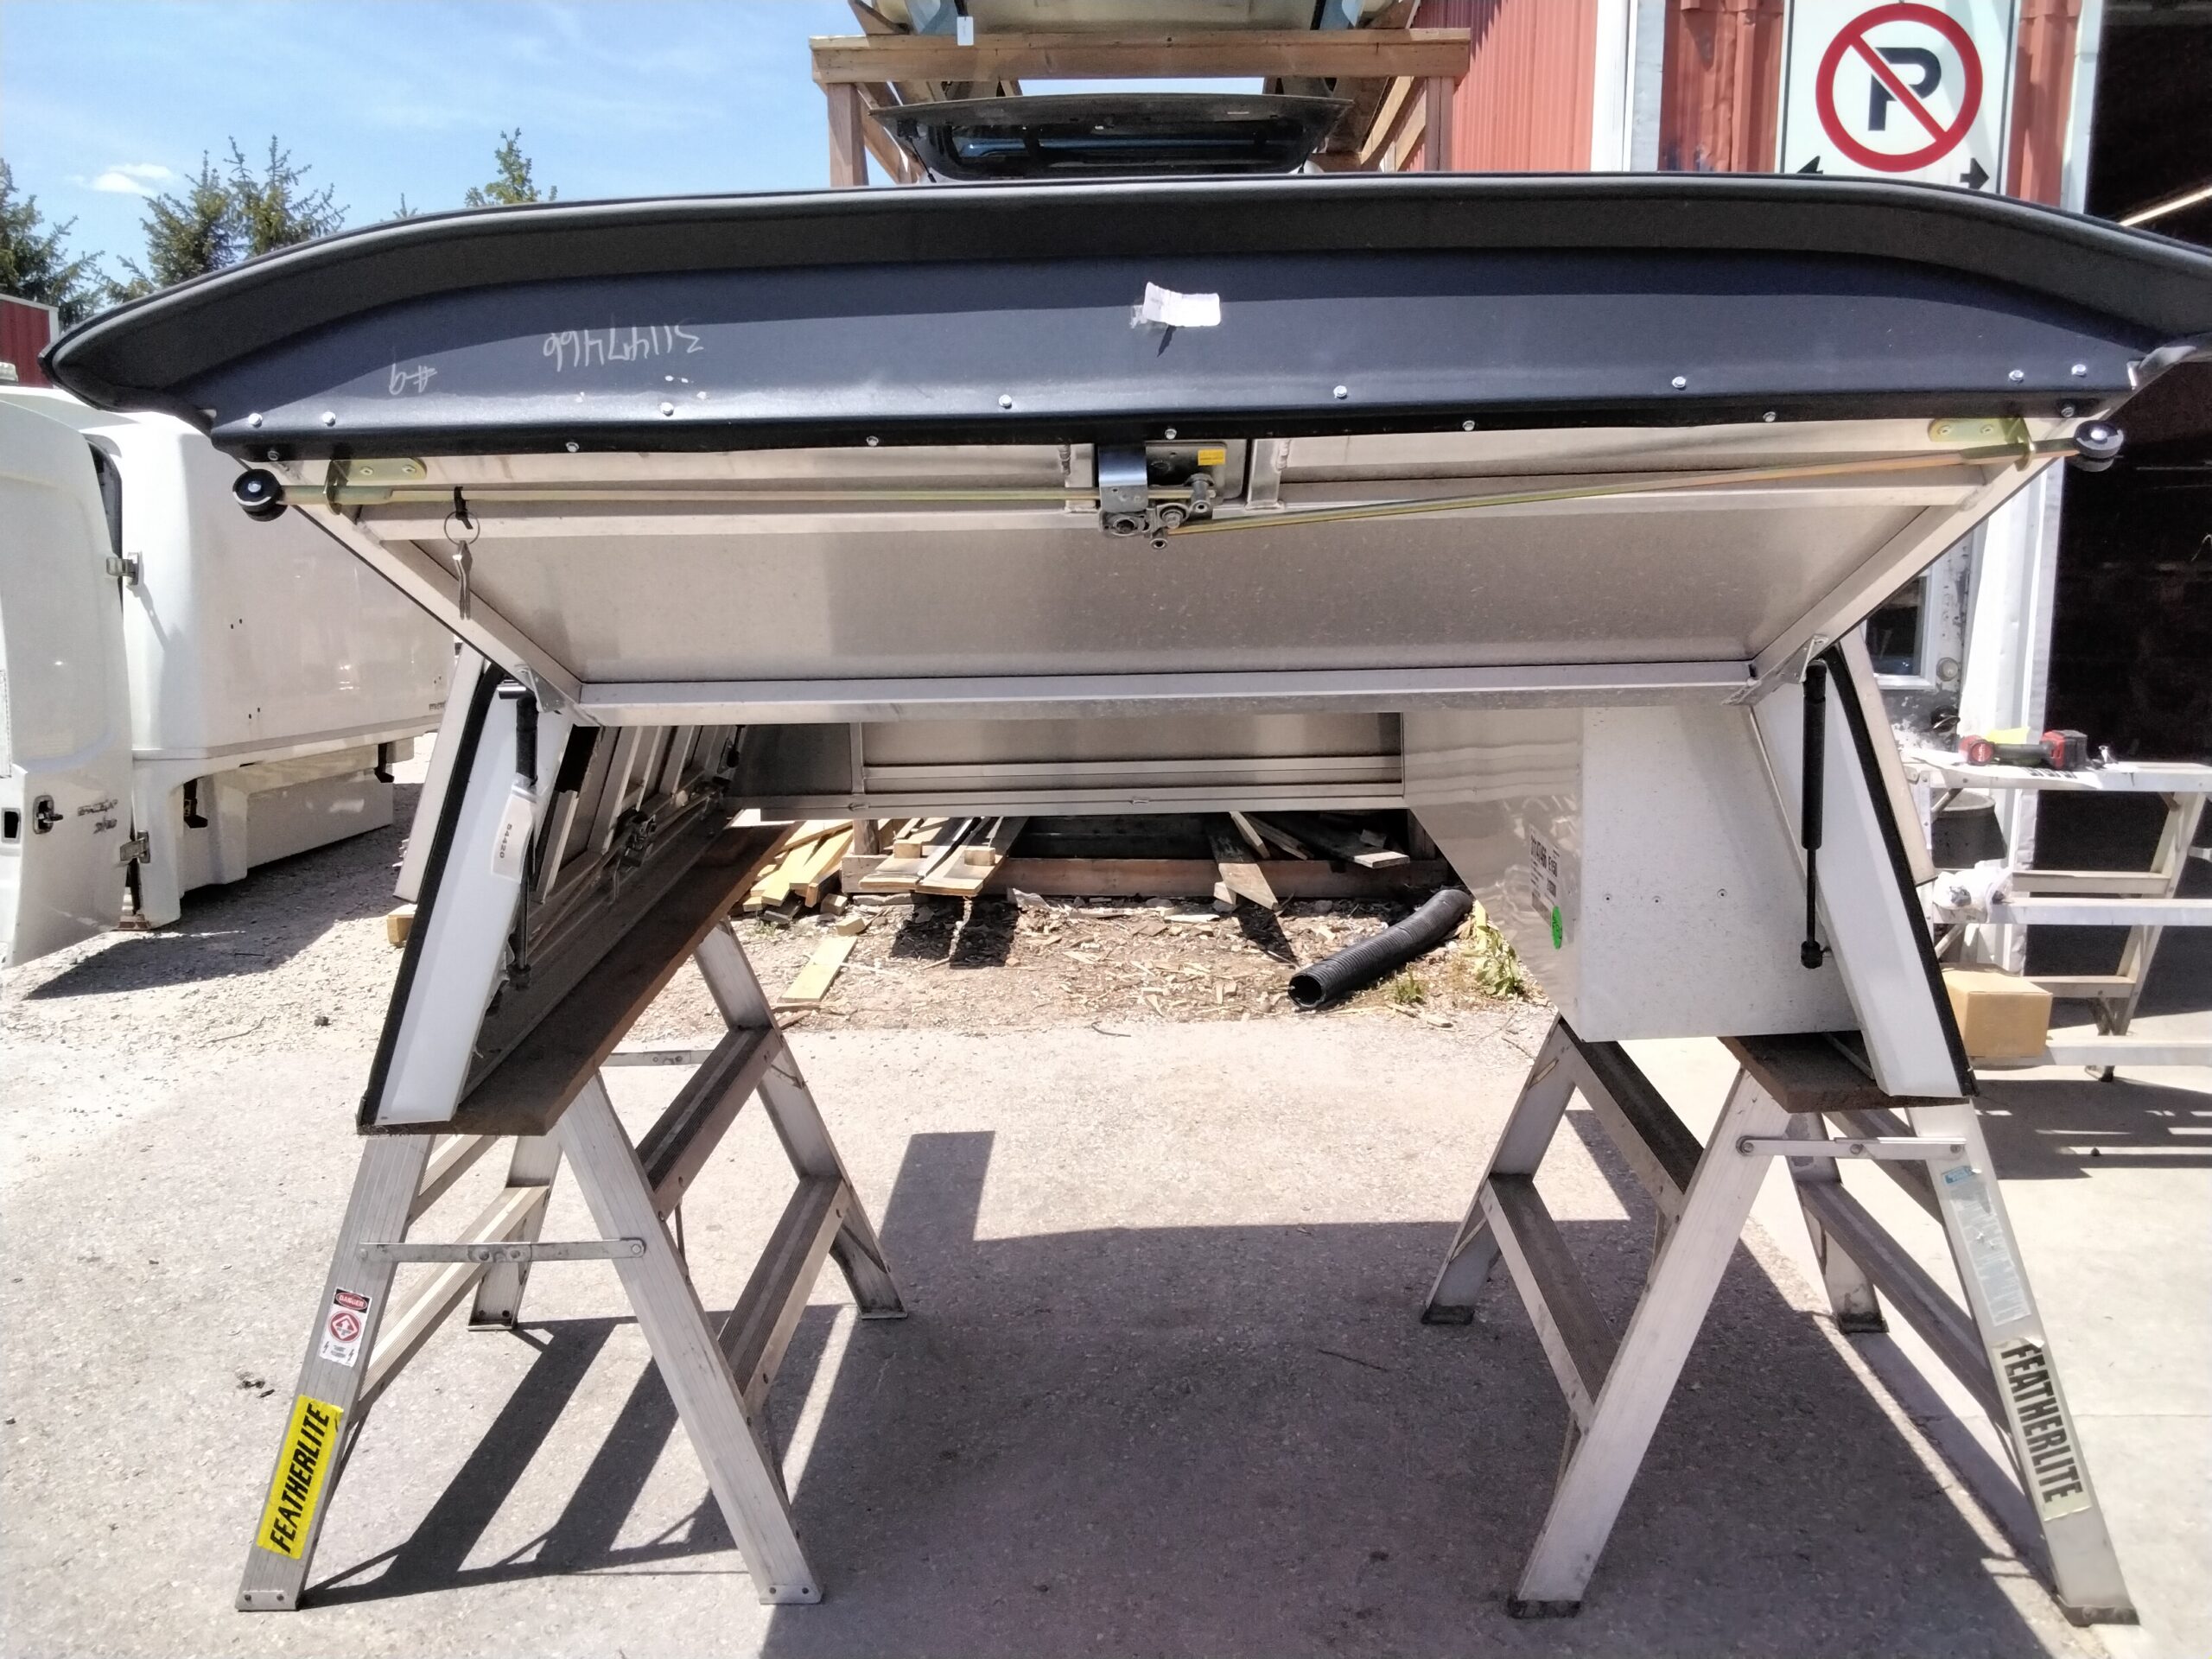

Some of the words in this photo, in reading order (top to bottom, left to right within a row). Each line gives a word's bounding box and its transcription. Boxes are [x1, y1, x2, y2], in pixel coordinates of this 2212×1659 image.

[1868, 47, 1942, 131] P
[270, 1402, 330, 1554] FEATHERLITE
[2001, 1344, 2083, 1503] FEATHERLITE
